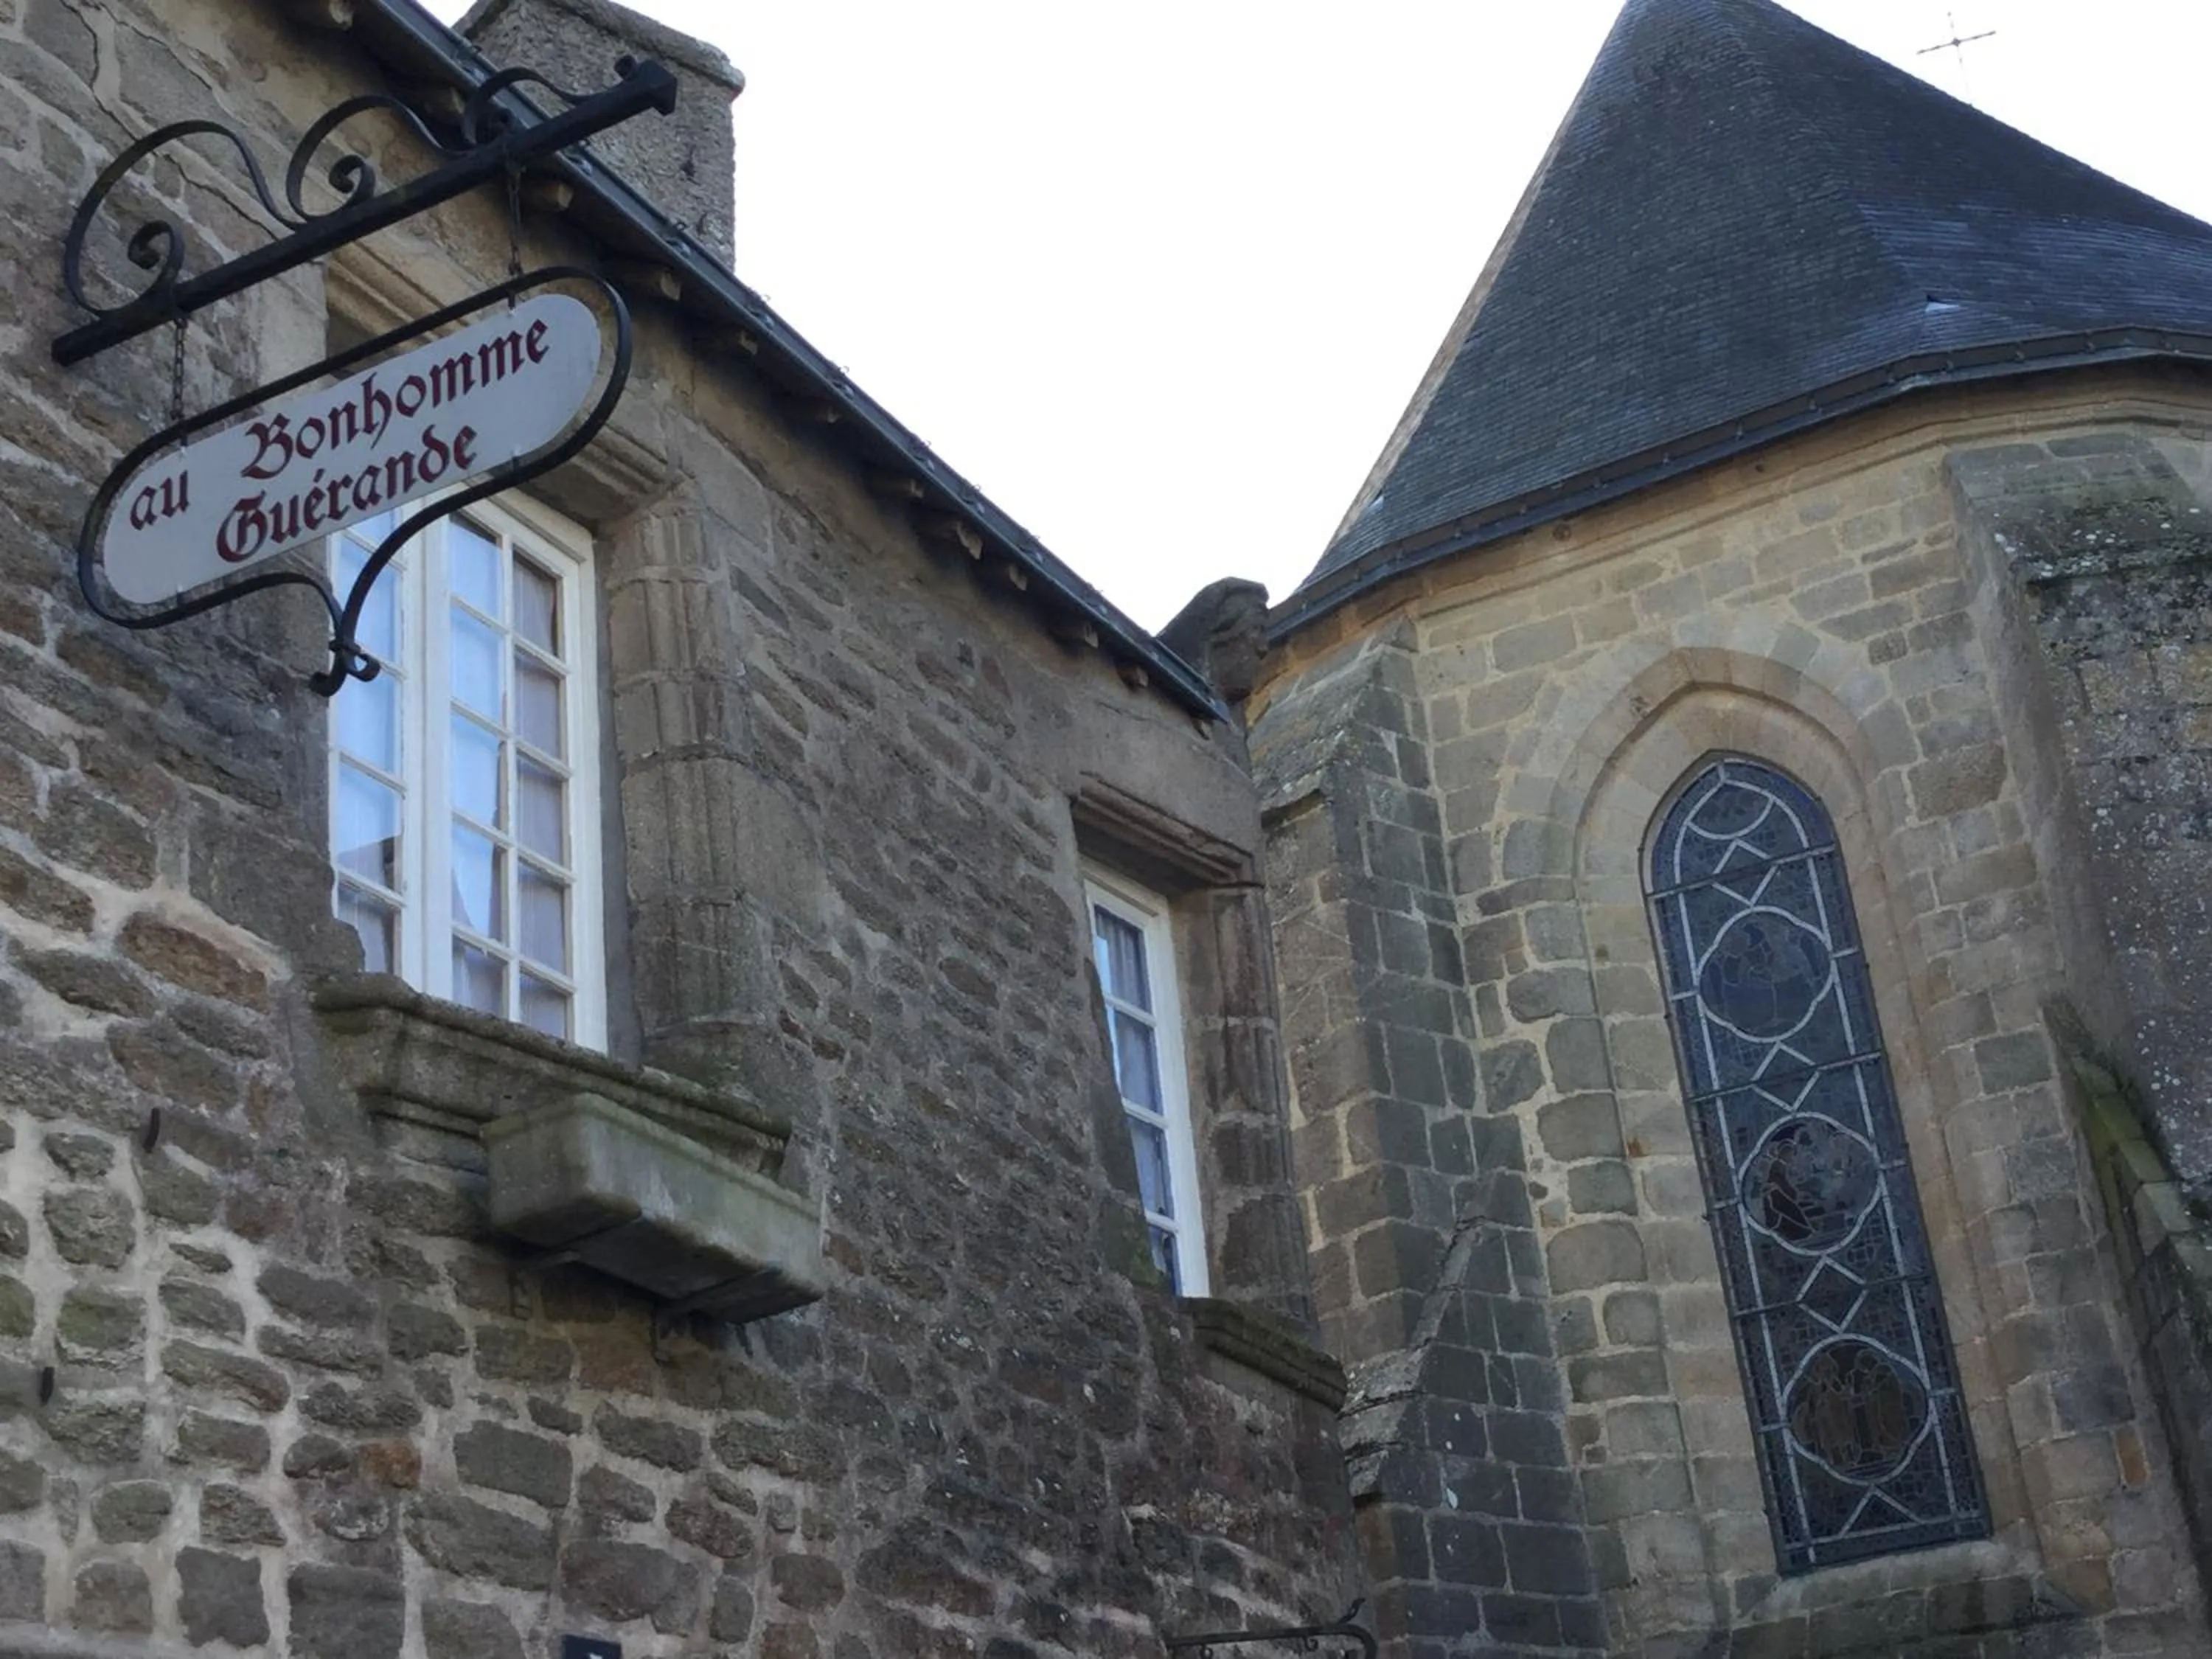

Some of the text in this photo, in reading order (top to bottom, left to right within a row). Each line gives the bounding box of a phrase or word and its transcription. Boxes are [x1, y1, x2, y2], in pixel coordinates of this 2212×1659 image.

[128, 319, 551, 532] au Bonhomme
[215, 424, 478, 563] Guérande
